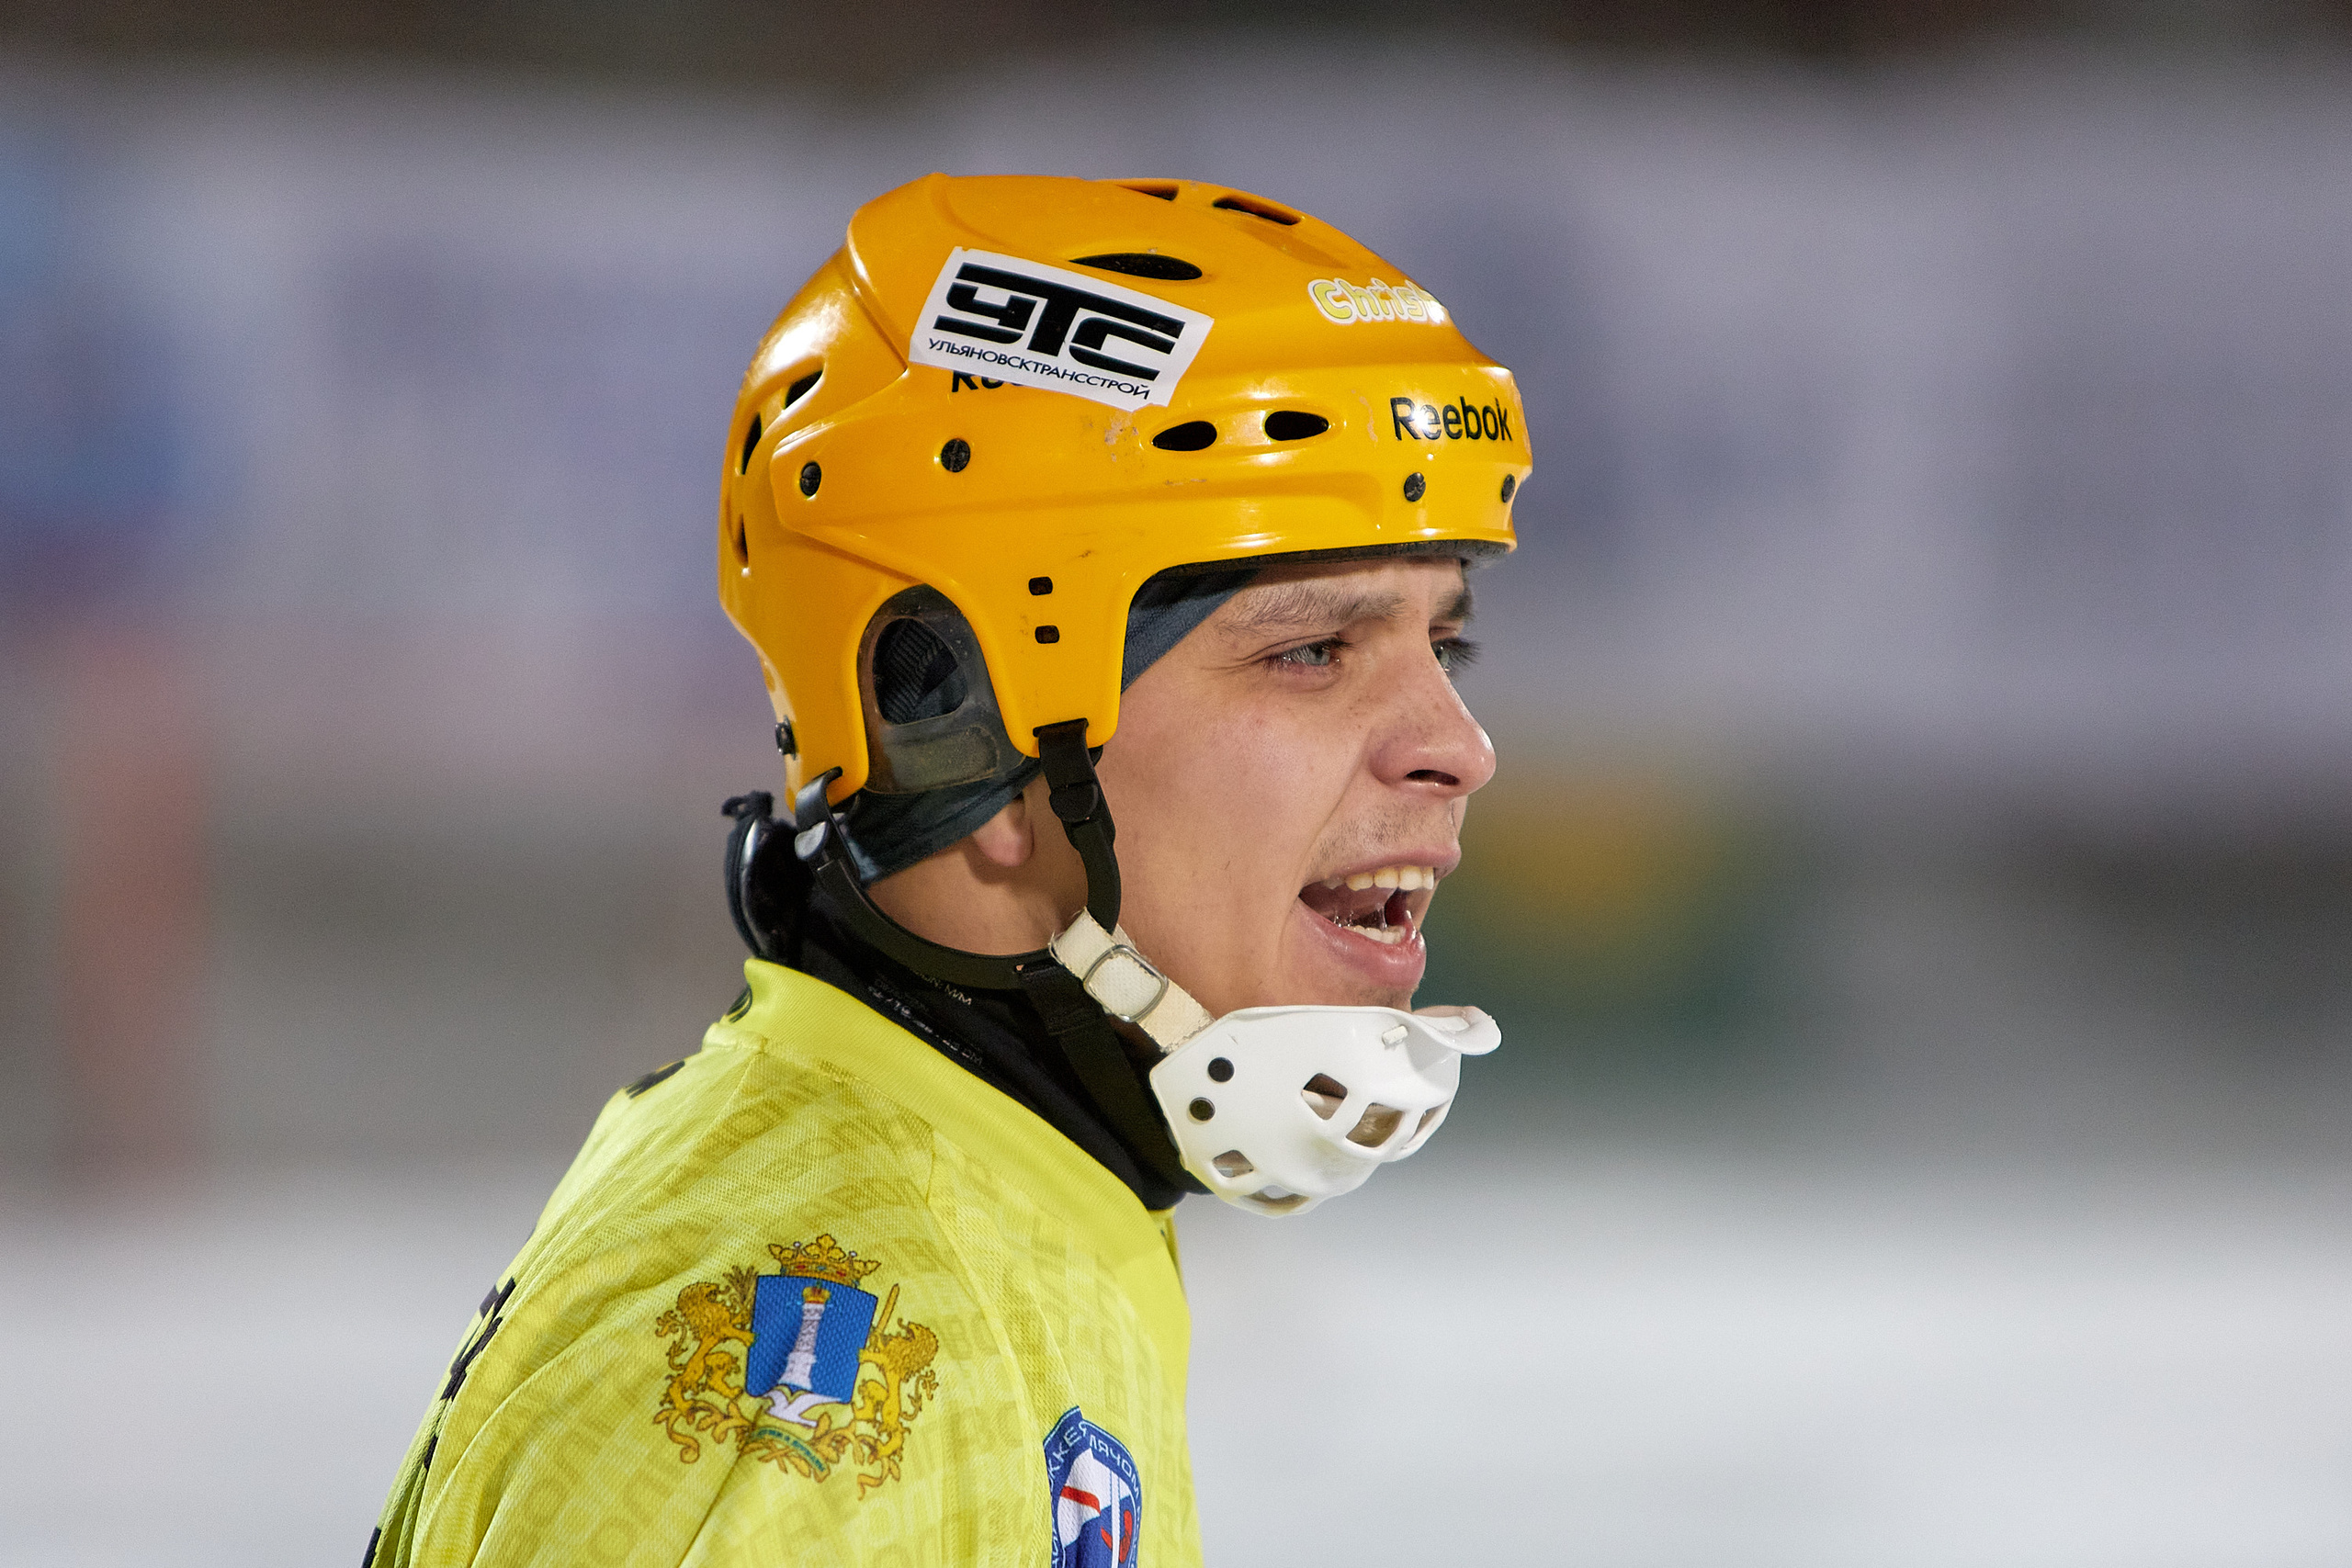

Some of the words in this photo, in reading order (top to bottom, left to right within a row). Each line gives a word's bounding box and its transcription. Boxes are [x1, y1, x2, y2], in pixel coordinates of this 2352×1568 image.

[933, 262, 1186, 382] УТС
[928, 337, 1150, 400] УЛЬЯНОВСКТРАНССТРОЙ
[1390, 396, 1513, 441] Reebok
